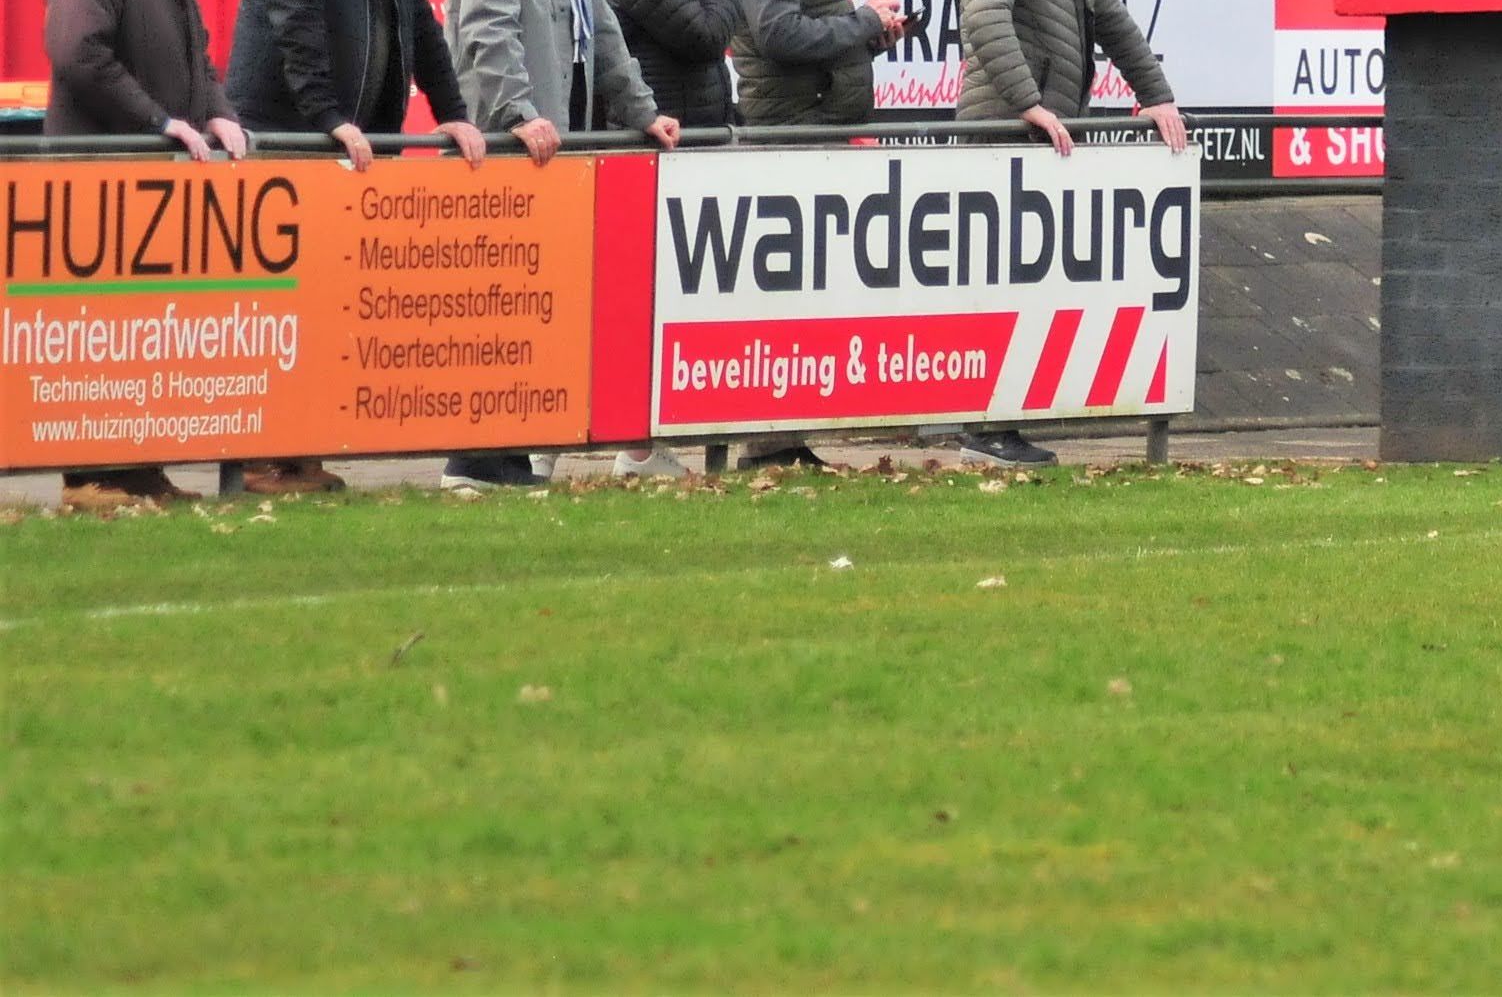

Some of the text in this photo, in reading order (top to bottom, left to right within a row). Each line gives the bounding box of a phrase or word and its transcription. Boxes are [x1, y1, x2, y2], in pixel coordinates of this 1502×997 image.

[4, 176, 300, 279] HUIZING
[360, 187, 535, 228] Gordijnenatelier
[359, 235, 540, 275] Meubelstoffering
[666, 157, 1192, 312] wardenburg
[358, 284, 553, 327] Scheepsstoffering
[1, 303, 299, 372] Interieurafwerking
[356, 336, 533, 370] Vloertechnieken
[30, 369, 269, 406] Techniekweg 8 Hoogezand
[671, 334, 987, 399] beveiliging & telecom
[32, 407, 263, 445] www.huizinghoogezand.nl
[355, 383, 568, 430] Rol/plisse gordijnen
